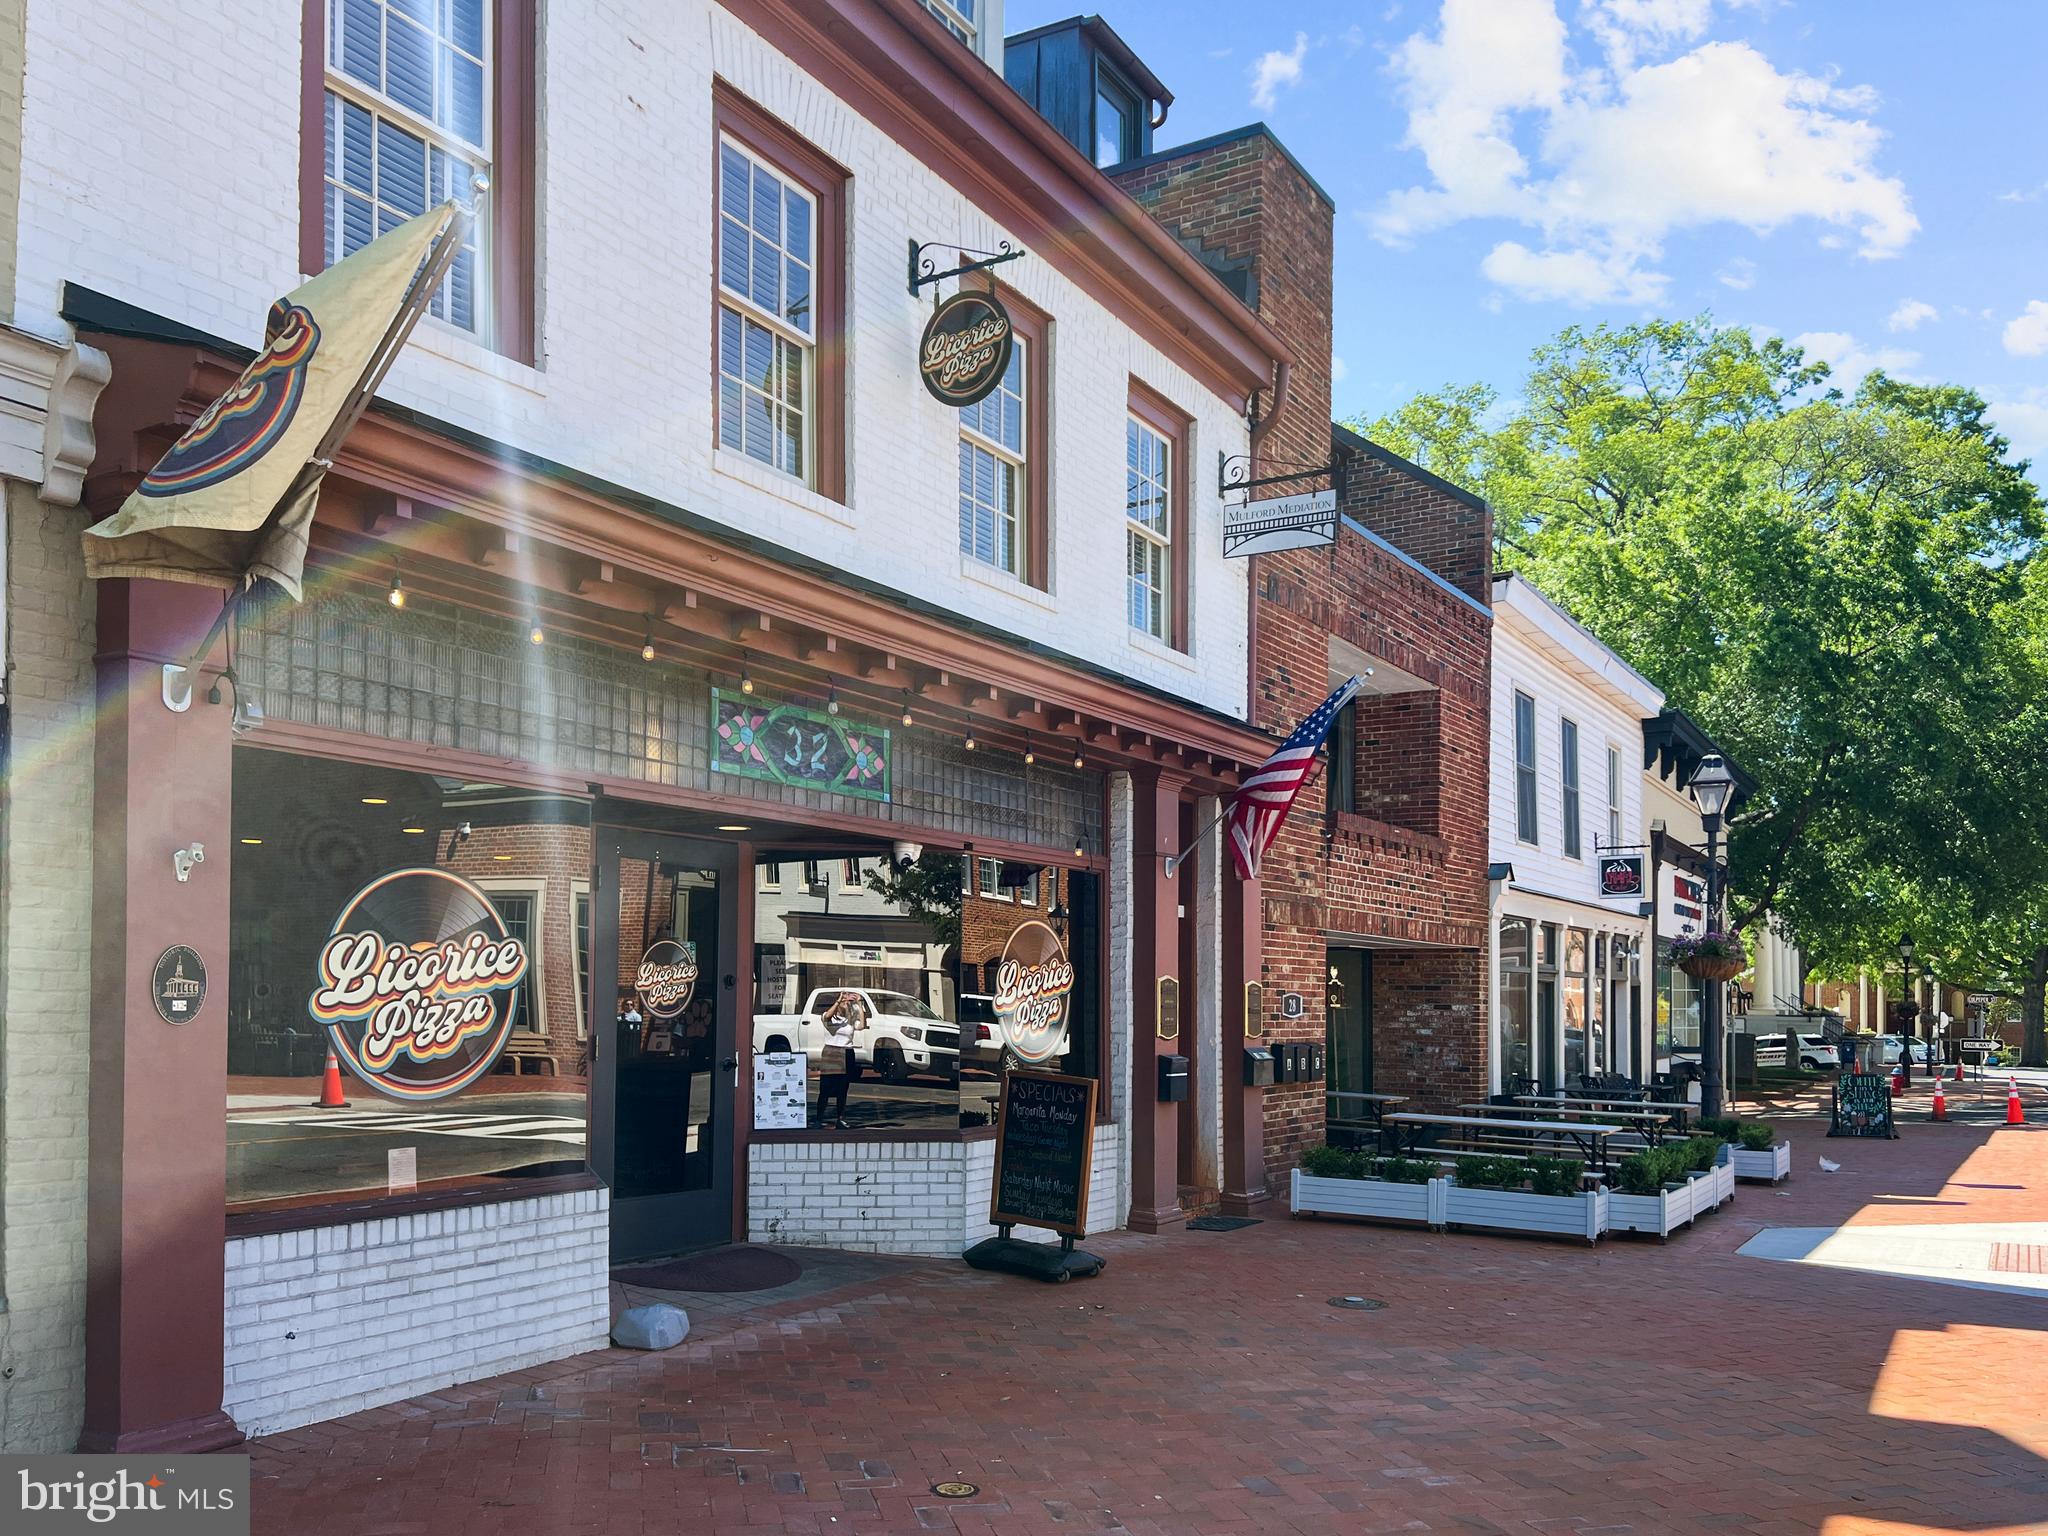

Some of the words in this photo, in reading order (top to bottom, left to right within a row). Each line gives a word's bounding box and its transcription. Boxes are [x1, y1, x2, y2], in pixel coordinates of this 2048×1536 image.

[923, 318, 1005, 368] Licorice
[942, 346, 992, 383] Pizza
[1228, 508, 1276, 523] MULFORD
[1277, 500, 1332, 516] MEDIATION
[783, 725, 829, 772] 32
[158, 947, 182, 969] HISTORIC
[183, 947, 204, 970] BUILDING
[317, 933, 523, 1010] Licorice
[636, 962, 696, 987] Licorice
[995, 961, 1072, 1006] Licorice
[650, 981, 686, 1003] Pizza
[1288, 999, 1297, 1013] 28
[366, 988, 490, 1058] Pizza
[1013, 995, 1060, 1036] Pizza
[1018, 1080, 1076, 1104] SPECIALS
[1012, 1102, 1046, 1120] Margarita
